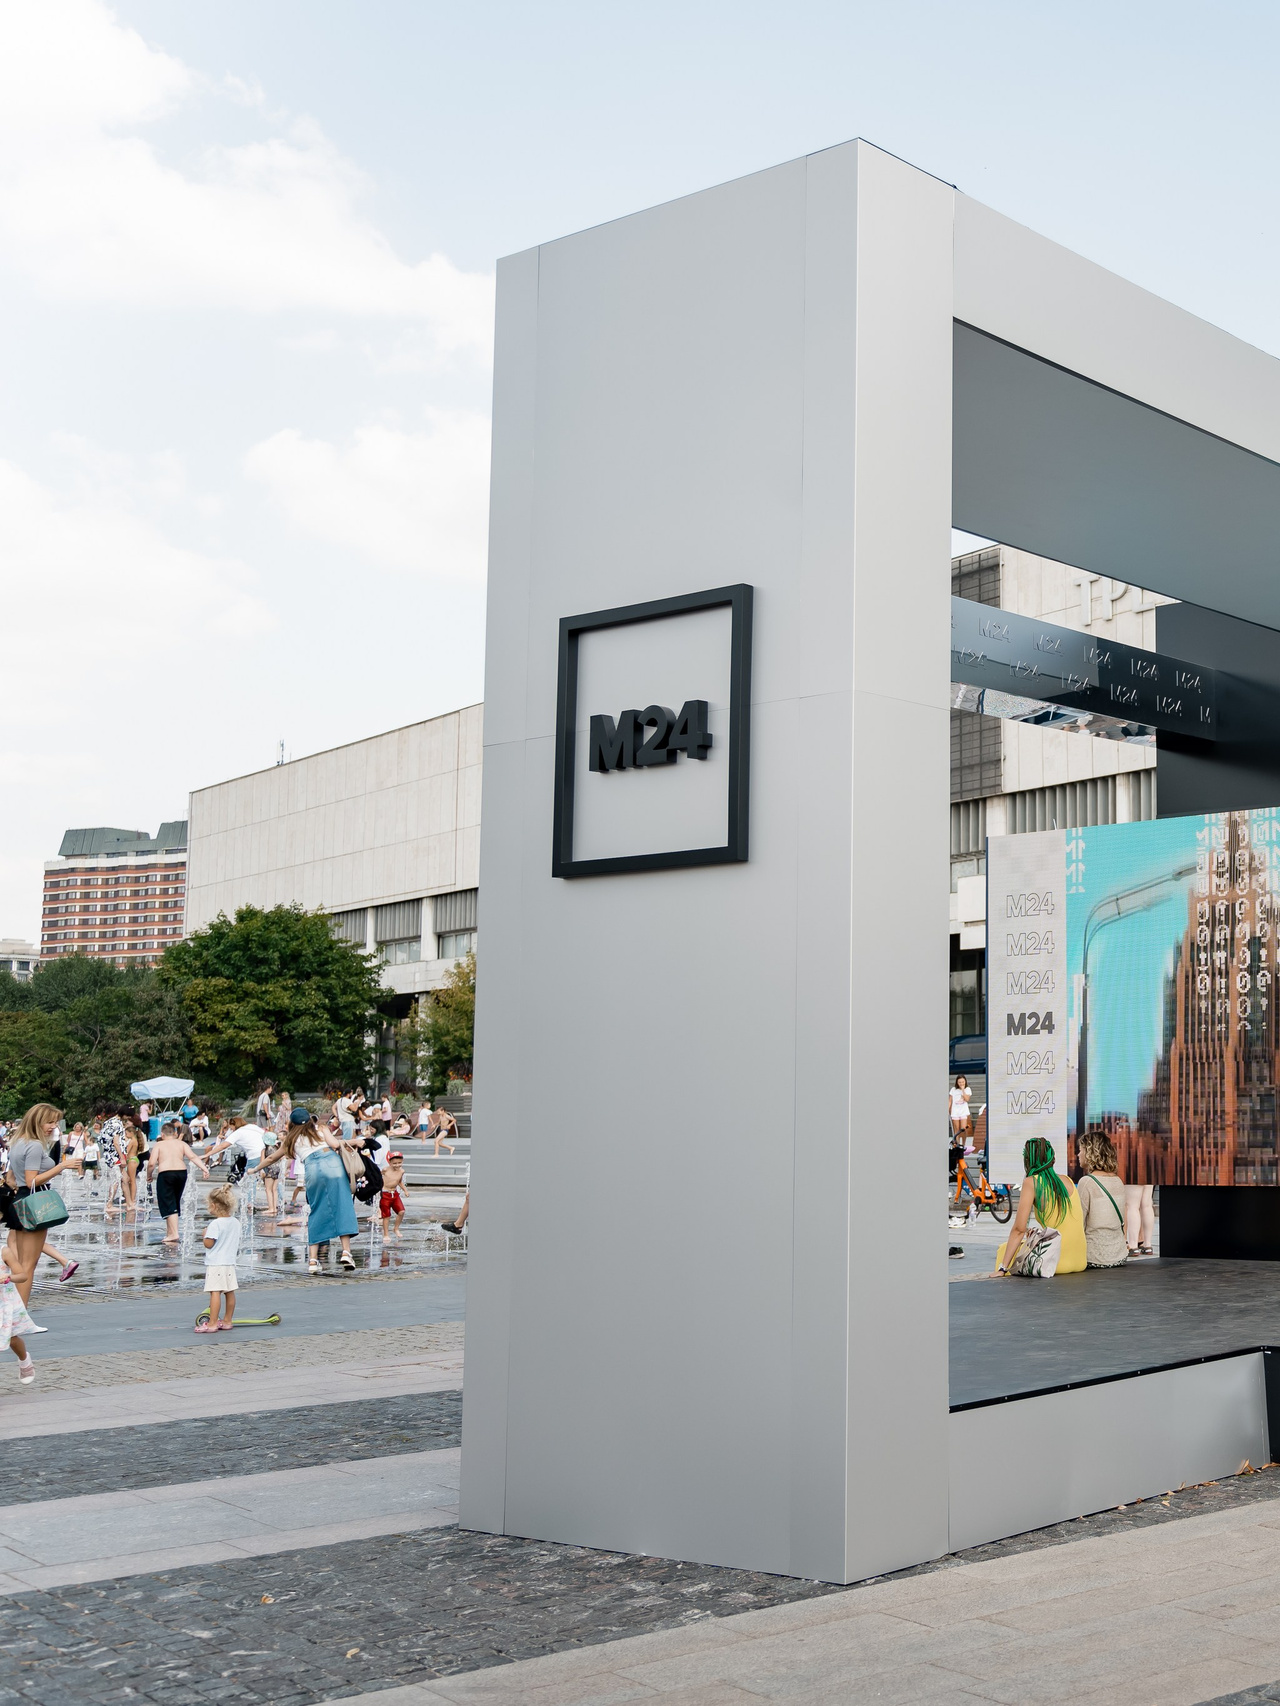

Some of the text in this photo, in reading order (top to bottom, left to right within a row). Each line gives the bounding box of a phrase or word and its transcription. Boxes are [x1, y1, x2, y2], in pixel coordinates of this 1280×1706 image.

[589, 699, 713, 773] М24
[1006, 892, 1055, 918] М24
[1006, 931, 1055, 957] М24
[1006, 970, 1055, 995] М24
[1006, 1012, 1055, 1036] М24
[1006, 1051, 1055, 1075] М24
[1006, 1090, 1055, 1115] М24
